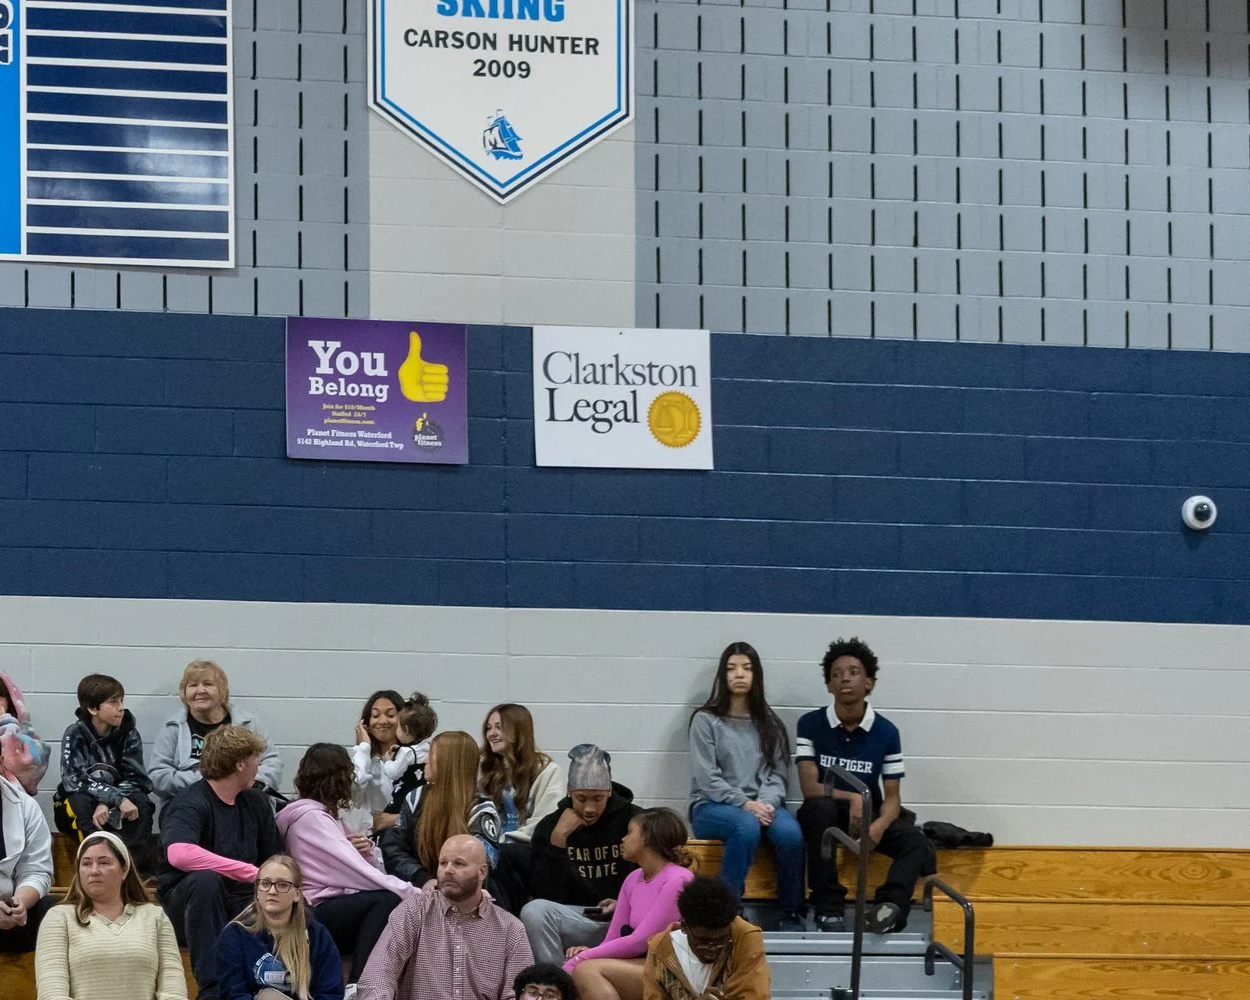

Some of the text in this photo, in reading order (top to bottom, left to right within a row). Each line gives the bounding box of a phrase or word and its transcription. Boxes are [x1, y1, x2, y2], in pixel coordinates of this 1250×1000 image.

[403, 28, 599, 56] CARSON HUNTER
[472, 59, 531, 79] 2009
[308, 340, 388, 376] You
[542, 351, 699, 387] Clarkston
[308, 377, 389, 403] Belong
[545, 387, 642, 434] Legal
[307, 429, 392, 439] Planet Fitness Waterford
[313, 438, 343, 447] Highland
[357, 440, 389, 448] Waterford
[594, 846, 609, 860] OF
[578, 862, 618, 879] STATE
